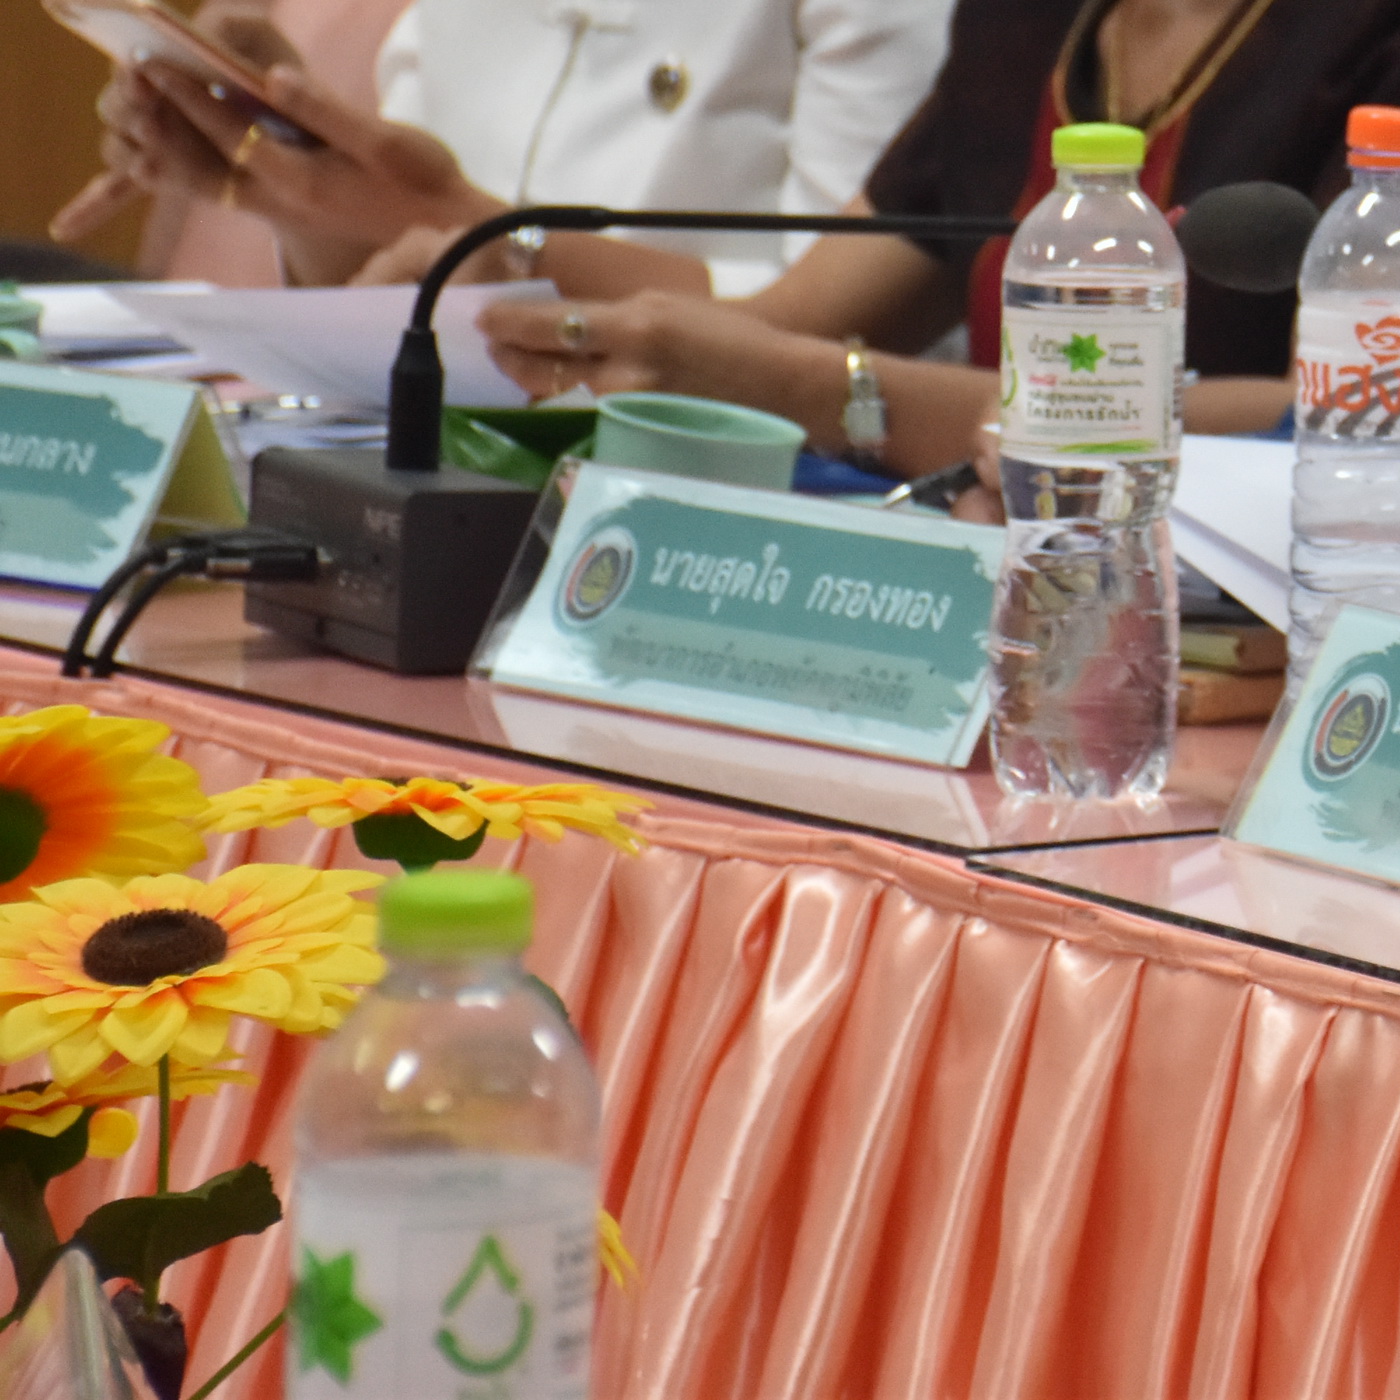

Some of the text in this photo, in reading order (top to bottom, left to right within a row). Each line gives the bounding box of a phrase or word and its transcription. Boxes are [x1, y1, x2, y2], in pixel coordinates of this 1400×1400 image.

[650, 542, 952, 633] นายสุดใจ กรองทอง
